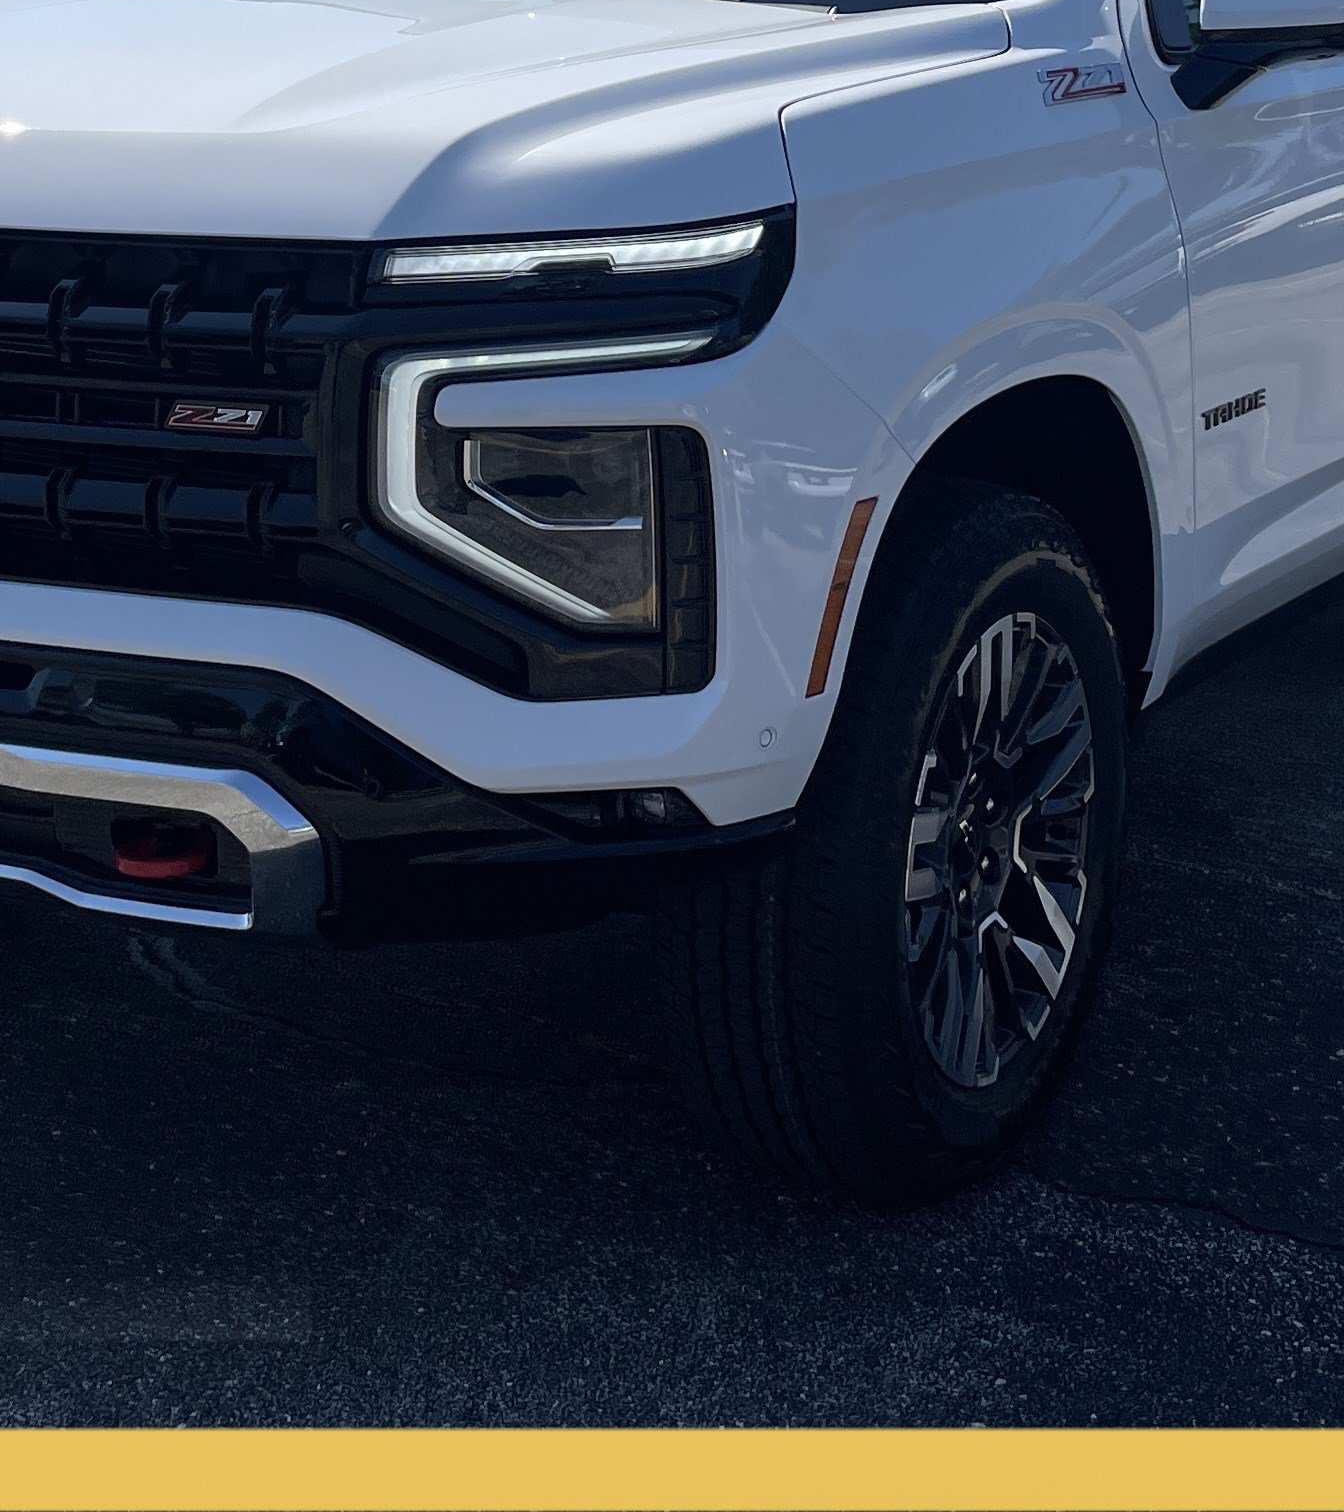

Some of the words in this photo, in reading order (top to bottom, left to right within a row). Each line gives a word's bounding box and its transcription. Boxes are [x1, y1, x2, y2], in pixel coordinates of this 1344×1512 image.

[1037, 63, 1126, 106] Z71
[168, 404, 263, 431] Z71
[1201, 388, 1266, 431] TAHOE
